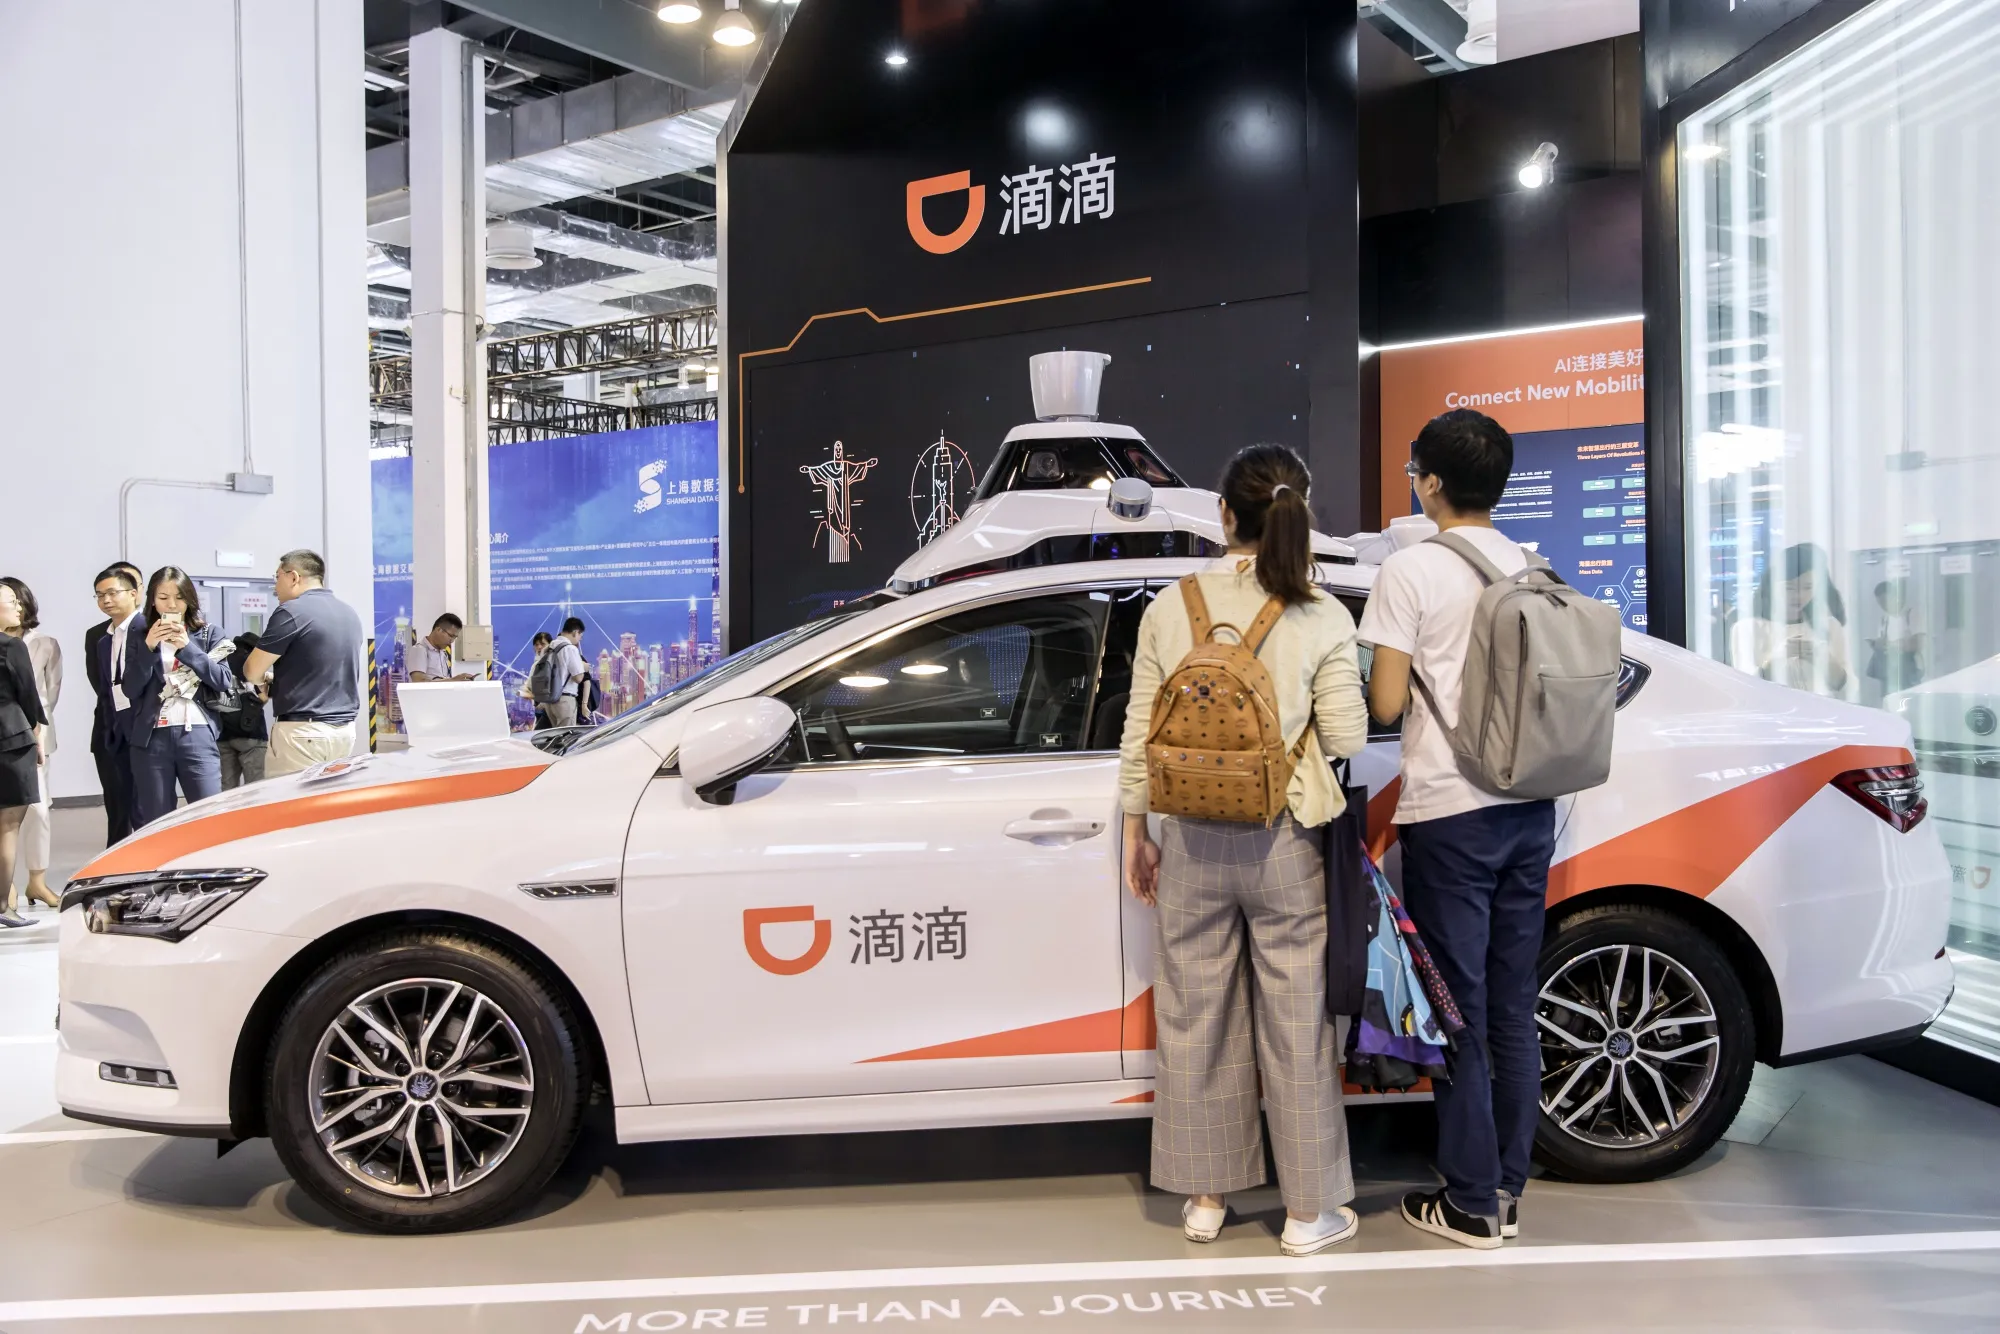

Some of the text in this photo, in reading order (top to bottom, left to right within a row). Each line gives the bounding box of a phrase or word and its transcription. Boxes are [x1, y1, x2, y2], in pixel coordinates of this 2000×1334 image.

[999, 152, 1116, 235] 滴滴
[1554, 348, 1643, 373] AI连接美好
[1445, 387, 1522, 409] Connect
[1527, 383, 1570, 401] New
[666, 496, 697, 505] SHANGHAI
[697, 495, 713, 503] DATA
[848, 905, 968, 965] 滴滴
[572, 1286, 1328, 1334] MORE THAN A JOURNEY
